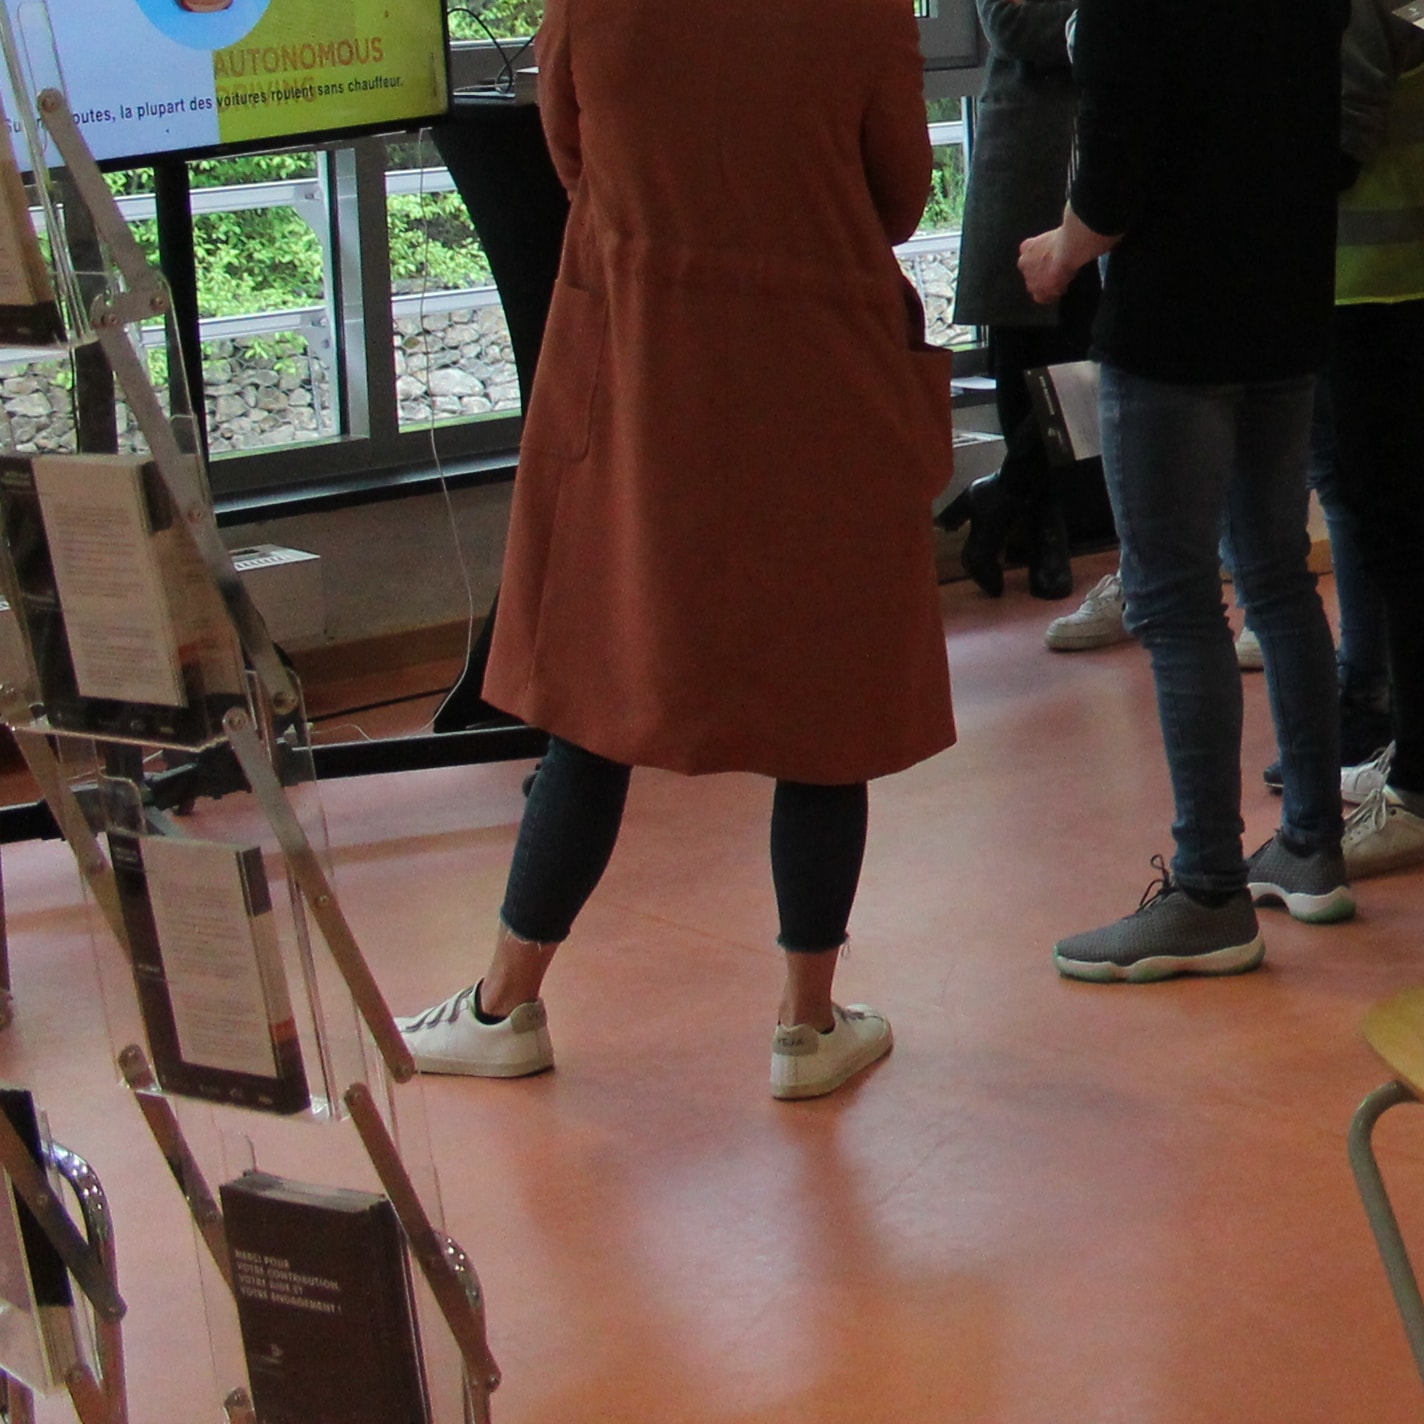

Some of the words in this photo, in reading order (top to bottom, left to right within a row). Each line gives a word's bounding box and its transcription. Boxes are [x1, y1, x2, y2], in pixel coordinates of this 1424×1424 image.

[213, 37, 384, 78] AUTONOMOUS
[73, 109, 117, 125] outes,
[120, 103, 133, 119] la
[137, 98, 186, 121] plupart
[190, 94, 213, 111] des
[216, 89, 268, 108] voitures
[270, 83, 315, 102] roulent
[317, 81, 345, 96] sans
[347, 75, 404, 93] chauffeur.
